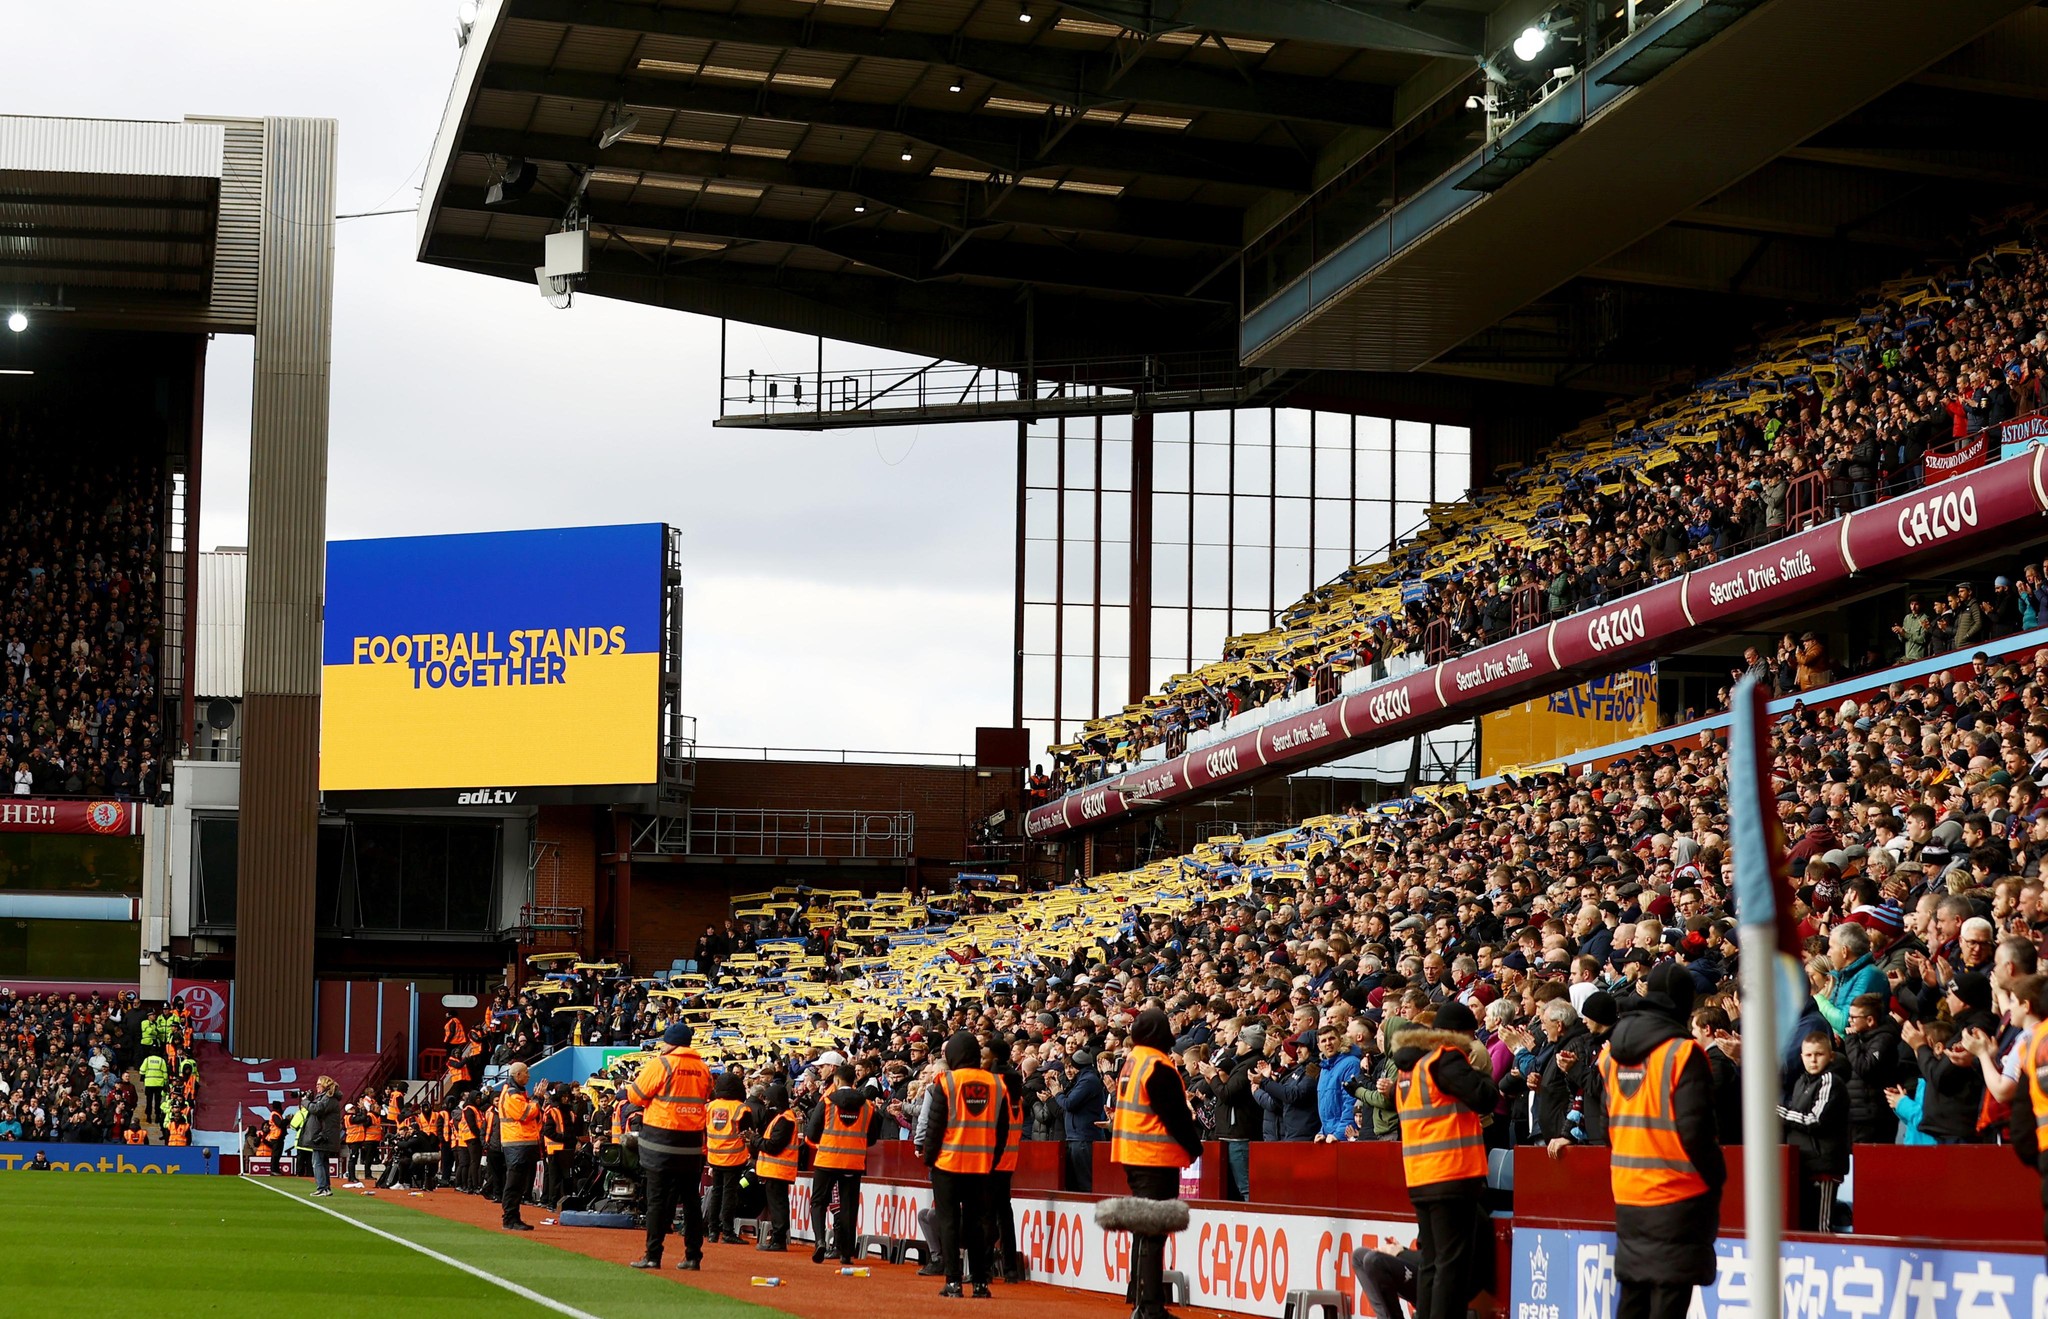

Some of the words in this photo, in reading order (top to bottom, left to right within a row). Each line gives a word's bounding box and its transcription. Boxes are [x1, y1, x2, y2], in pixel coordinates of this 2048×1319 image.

[2001, 421, 2030, 443] ASTON
[1898, 486, 1978, 547] CAZOO
[1709, 573, 1749, 606] Search.
[1748, 563, 1780, 589] Drive.
[1779, 550, 1816, 581] Smile.
[353, 632, 503, 664] FOOTBALL
[508, 625, 627, 660] STANDS
[1588, 604, 1645, 651] CAZOO
[408, 655, 567, 689] TOGETHER
[1456, 664, 1486, 691] Search.
[1484, 658, 1508, 683] Drive.
[1506, 648, 1533, 673] Smile.
[1369, 685, 1411, 725] CAZOO
[1272, 733, 1294, 752] Search.
[1293, 727, 1310, 746] Drive.
[1309, 718, 1331, 739] Smile.
[1205, 745, 1239, 778] CAZOO
[457, 788, 518, 805] adi.tv
[1080, 791, 1107, 820] CAZOO
[676, 1106, 702, 1114] CAZOO
[965, 1085, 987, 1098] K2
[874, 1193, 918, 1240] CAZOO
[1021, 1208, 1084, 1277] CAZOO
[1199, 1221, 1289, 1304] CAZOO
